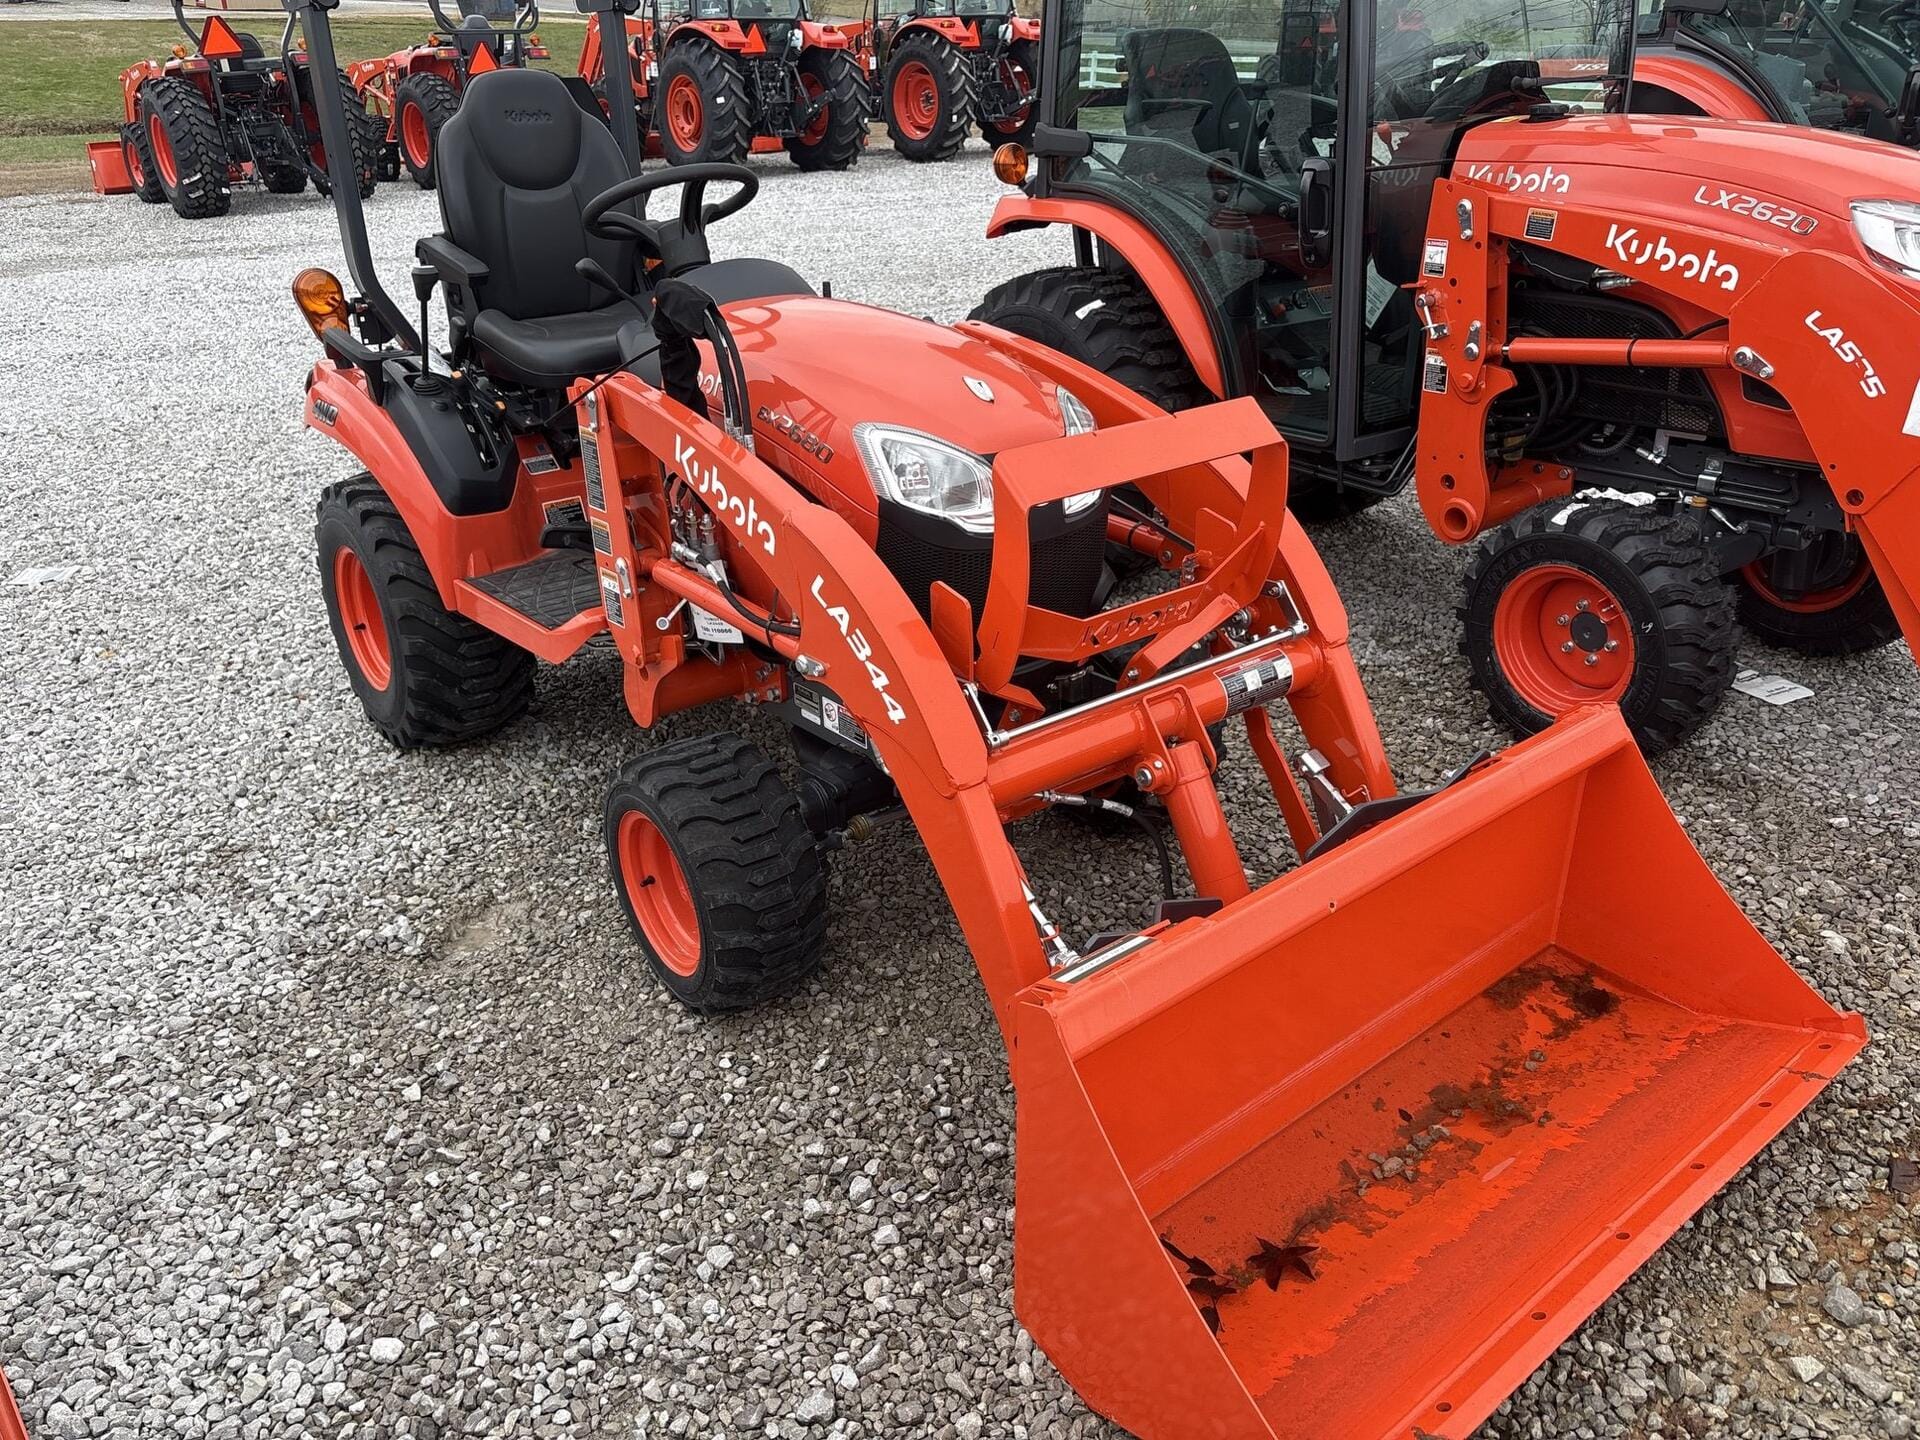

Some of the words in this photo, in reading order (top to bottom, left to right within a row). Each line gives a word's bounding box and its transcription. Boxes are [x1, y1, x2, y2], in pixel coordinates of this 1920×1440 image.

[1693, 185, 1819, 236] LX2620
[1604, 223, 1740, 291] Kubota
[757, 406, 835, 465] BX2680
[675, 433, 776, 557] Kubota
[810, 574, 907, 725] LA344
[1081, 600, 1192, 648] Kubota
